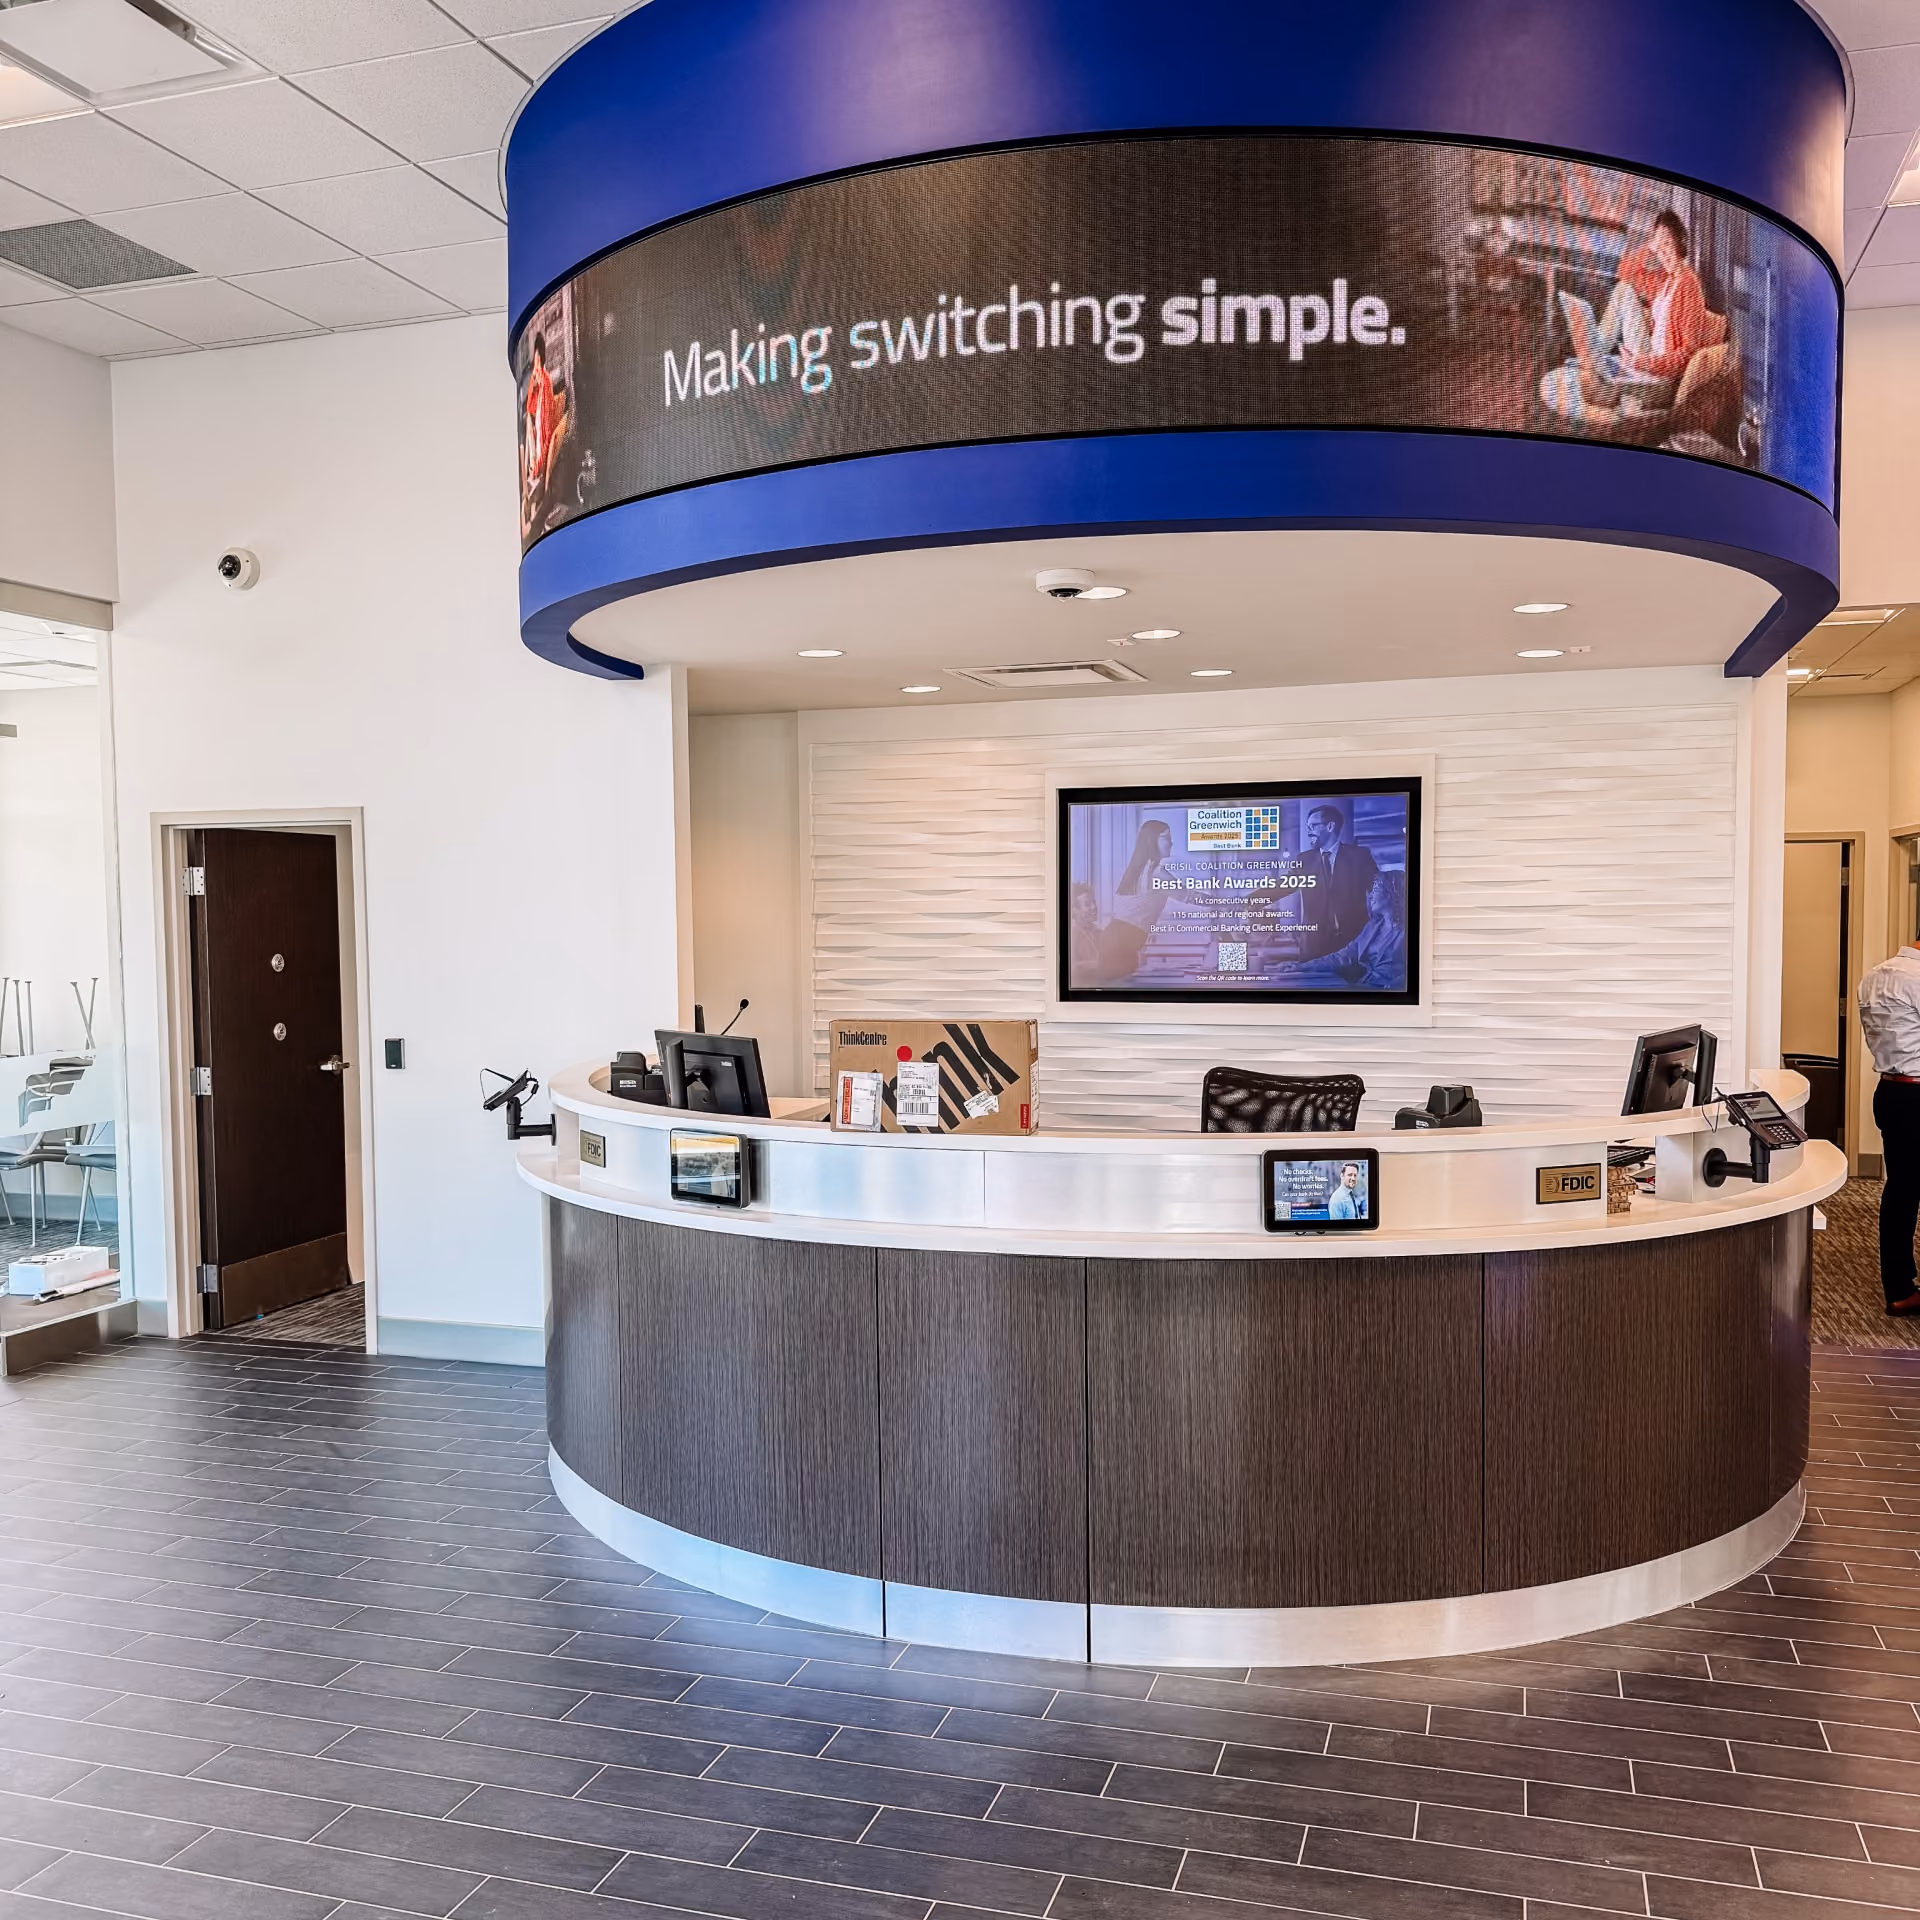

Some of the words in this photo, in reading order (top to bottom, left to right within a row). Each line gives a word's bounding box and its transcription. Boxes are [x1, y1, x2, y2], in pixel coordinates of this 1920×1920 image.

[663, 322, 831, 406] Making
[849, 282, 1147, 368] switching
[1160, 277, 1407, 361] simple.
[1197, 810, 1242, 819] Coalition
[1190, 820, 1242, 829] Greenwich
[1200, 832, 1222, 840] Awards
[1164, 862, 1194, 871] CRISIL
[1195, 861, 1244, 871] COALITION
[1246, 860, 1303, 870] GREENWICH
[1152, 877, 1183, 890] Best
[1186, 876, 1221, 889] Bank
[1223, 876, 1276, 889] Awards
[1279, 875, 1317, 888] 2025
[1194, 897, 1204, 905] 14
[1205, 896, 1249, 905] consecutive
[1250, 897, 1273, 907] years.
[1188, 909, 1217, 918] national
[1219, 910, 1233, 918] and
[1234, 909, 1264, 920] regional
[1265, 909, 1296, 918] awards.
[1150, 924, 1167, 933] Best
[1168, 924, 1175, 932] in
[1176, 924, 1219, 933] Commercial
[1221, 924, 1251, 934] Banking
[1252, 923, 1274, 932] Client
[1275, 924, 1318, 934] Experience!
[838, 1030, 887, 1046] ThinkCentre
[587, 1142, 602, 1157] FDIC
[1561, 1175, 1595, 1192] FDIC
